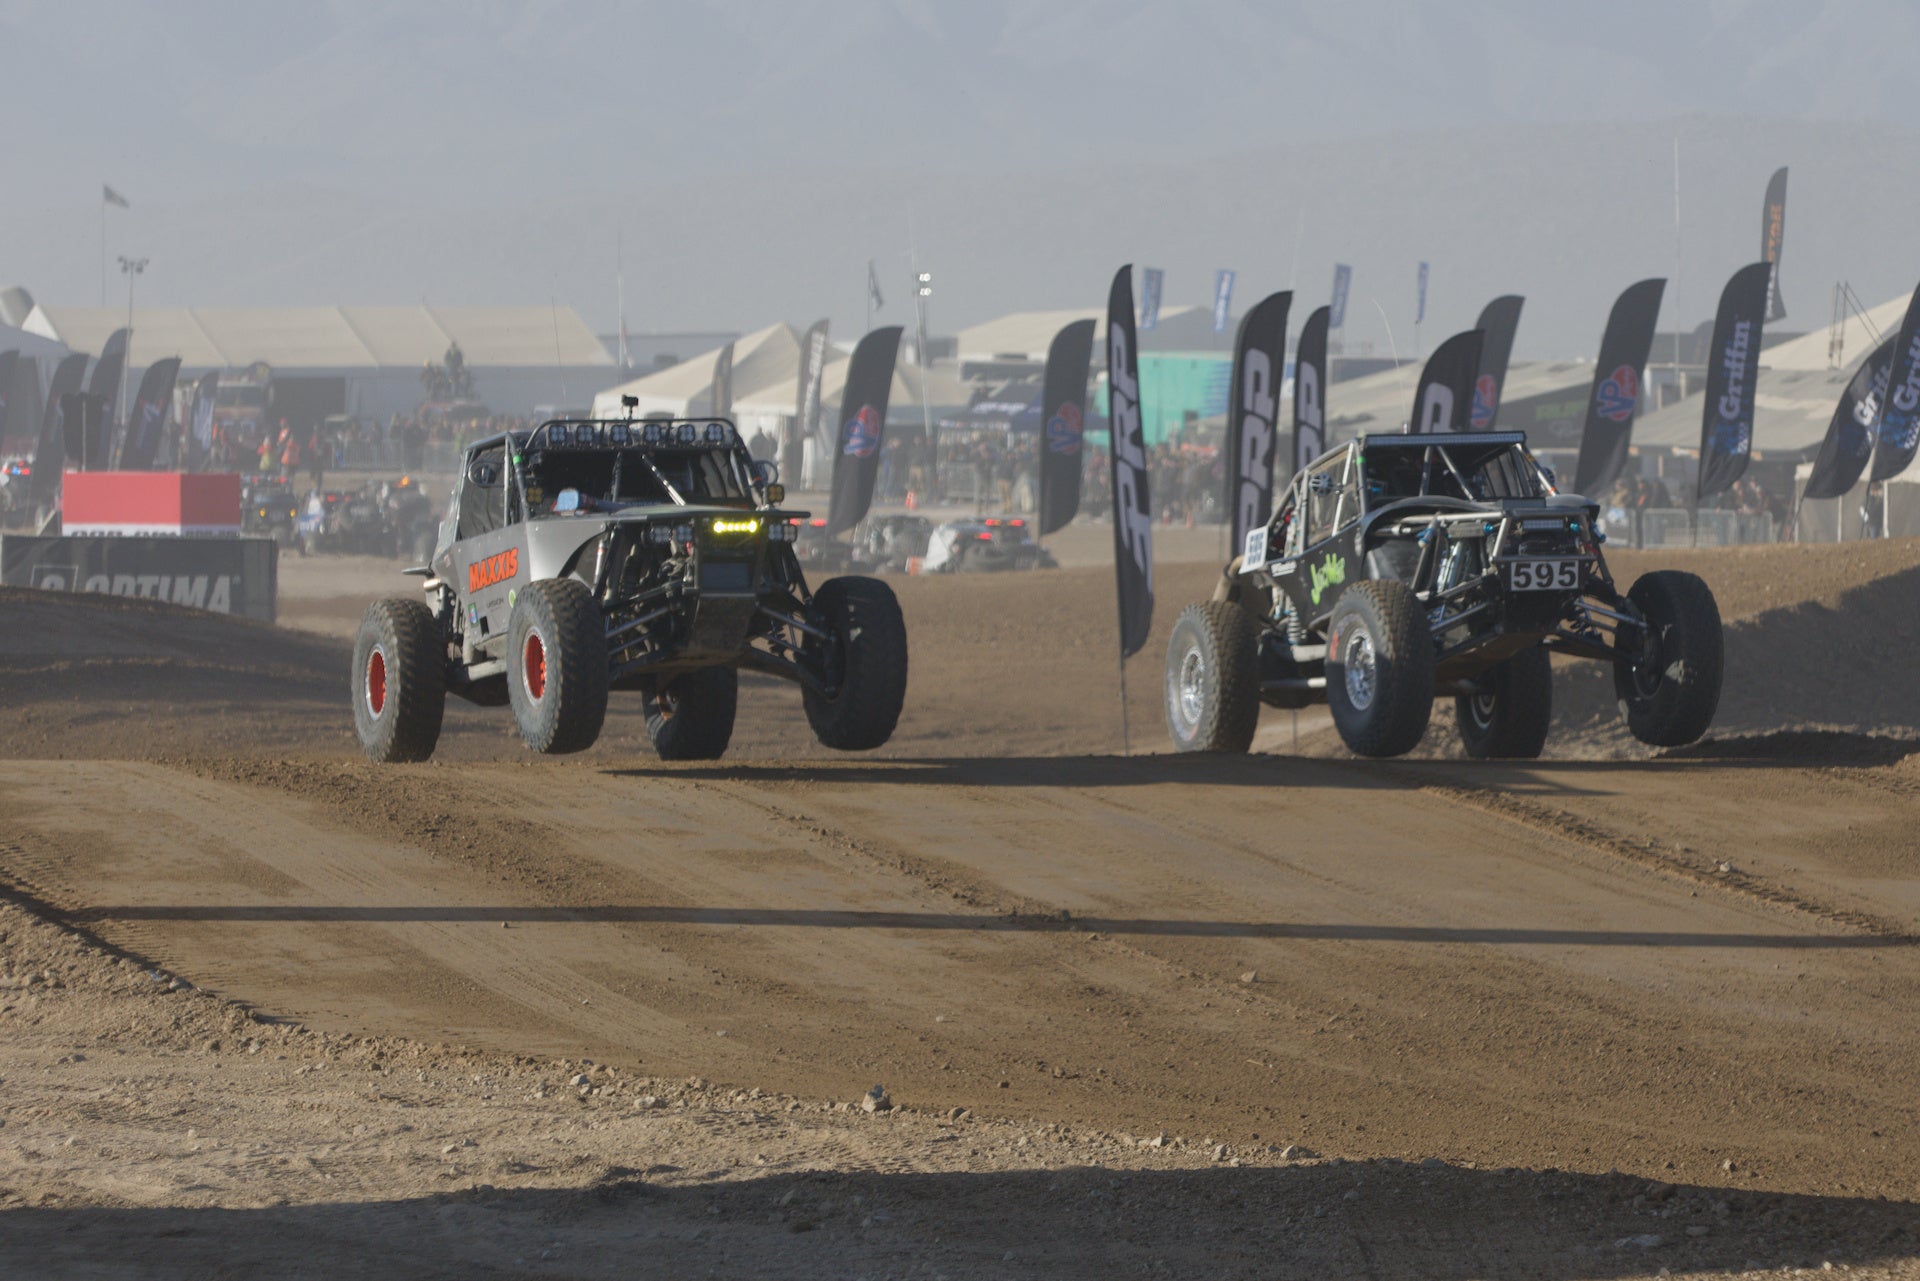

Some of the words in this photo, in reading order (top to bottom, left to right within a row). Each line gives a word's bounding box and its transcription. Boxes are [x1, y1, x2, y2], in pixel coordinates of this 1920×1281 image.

[1718, 319, 1751, 420] Griffin
[1596, 379, 1637, 418] VP
[843, 418, 879, 455] VP
[1109, 321, 1153, 594] PRP
[468, 547, 519, 594] MAXXIS
[1513, 562, 1577, 589] 595
